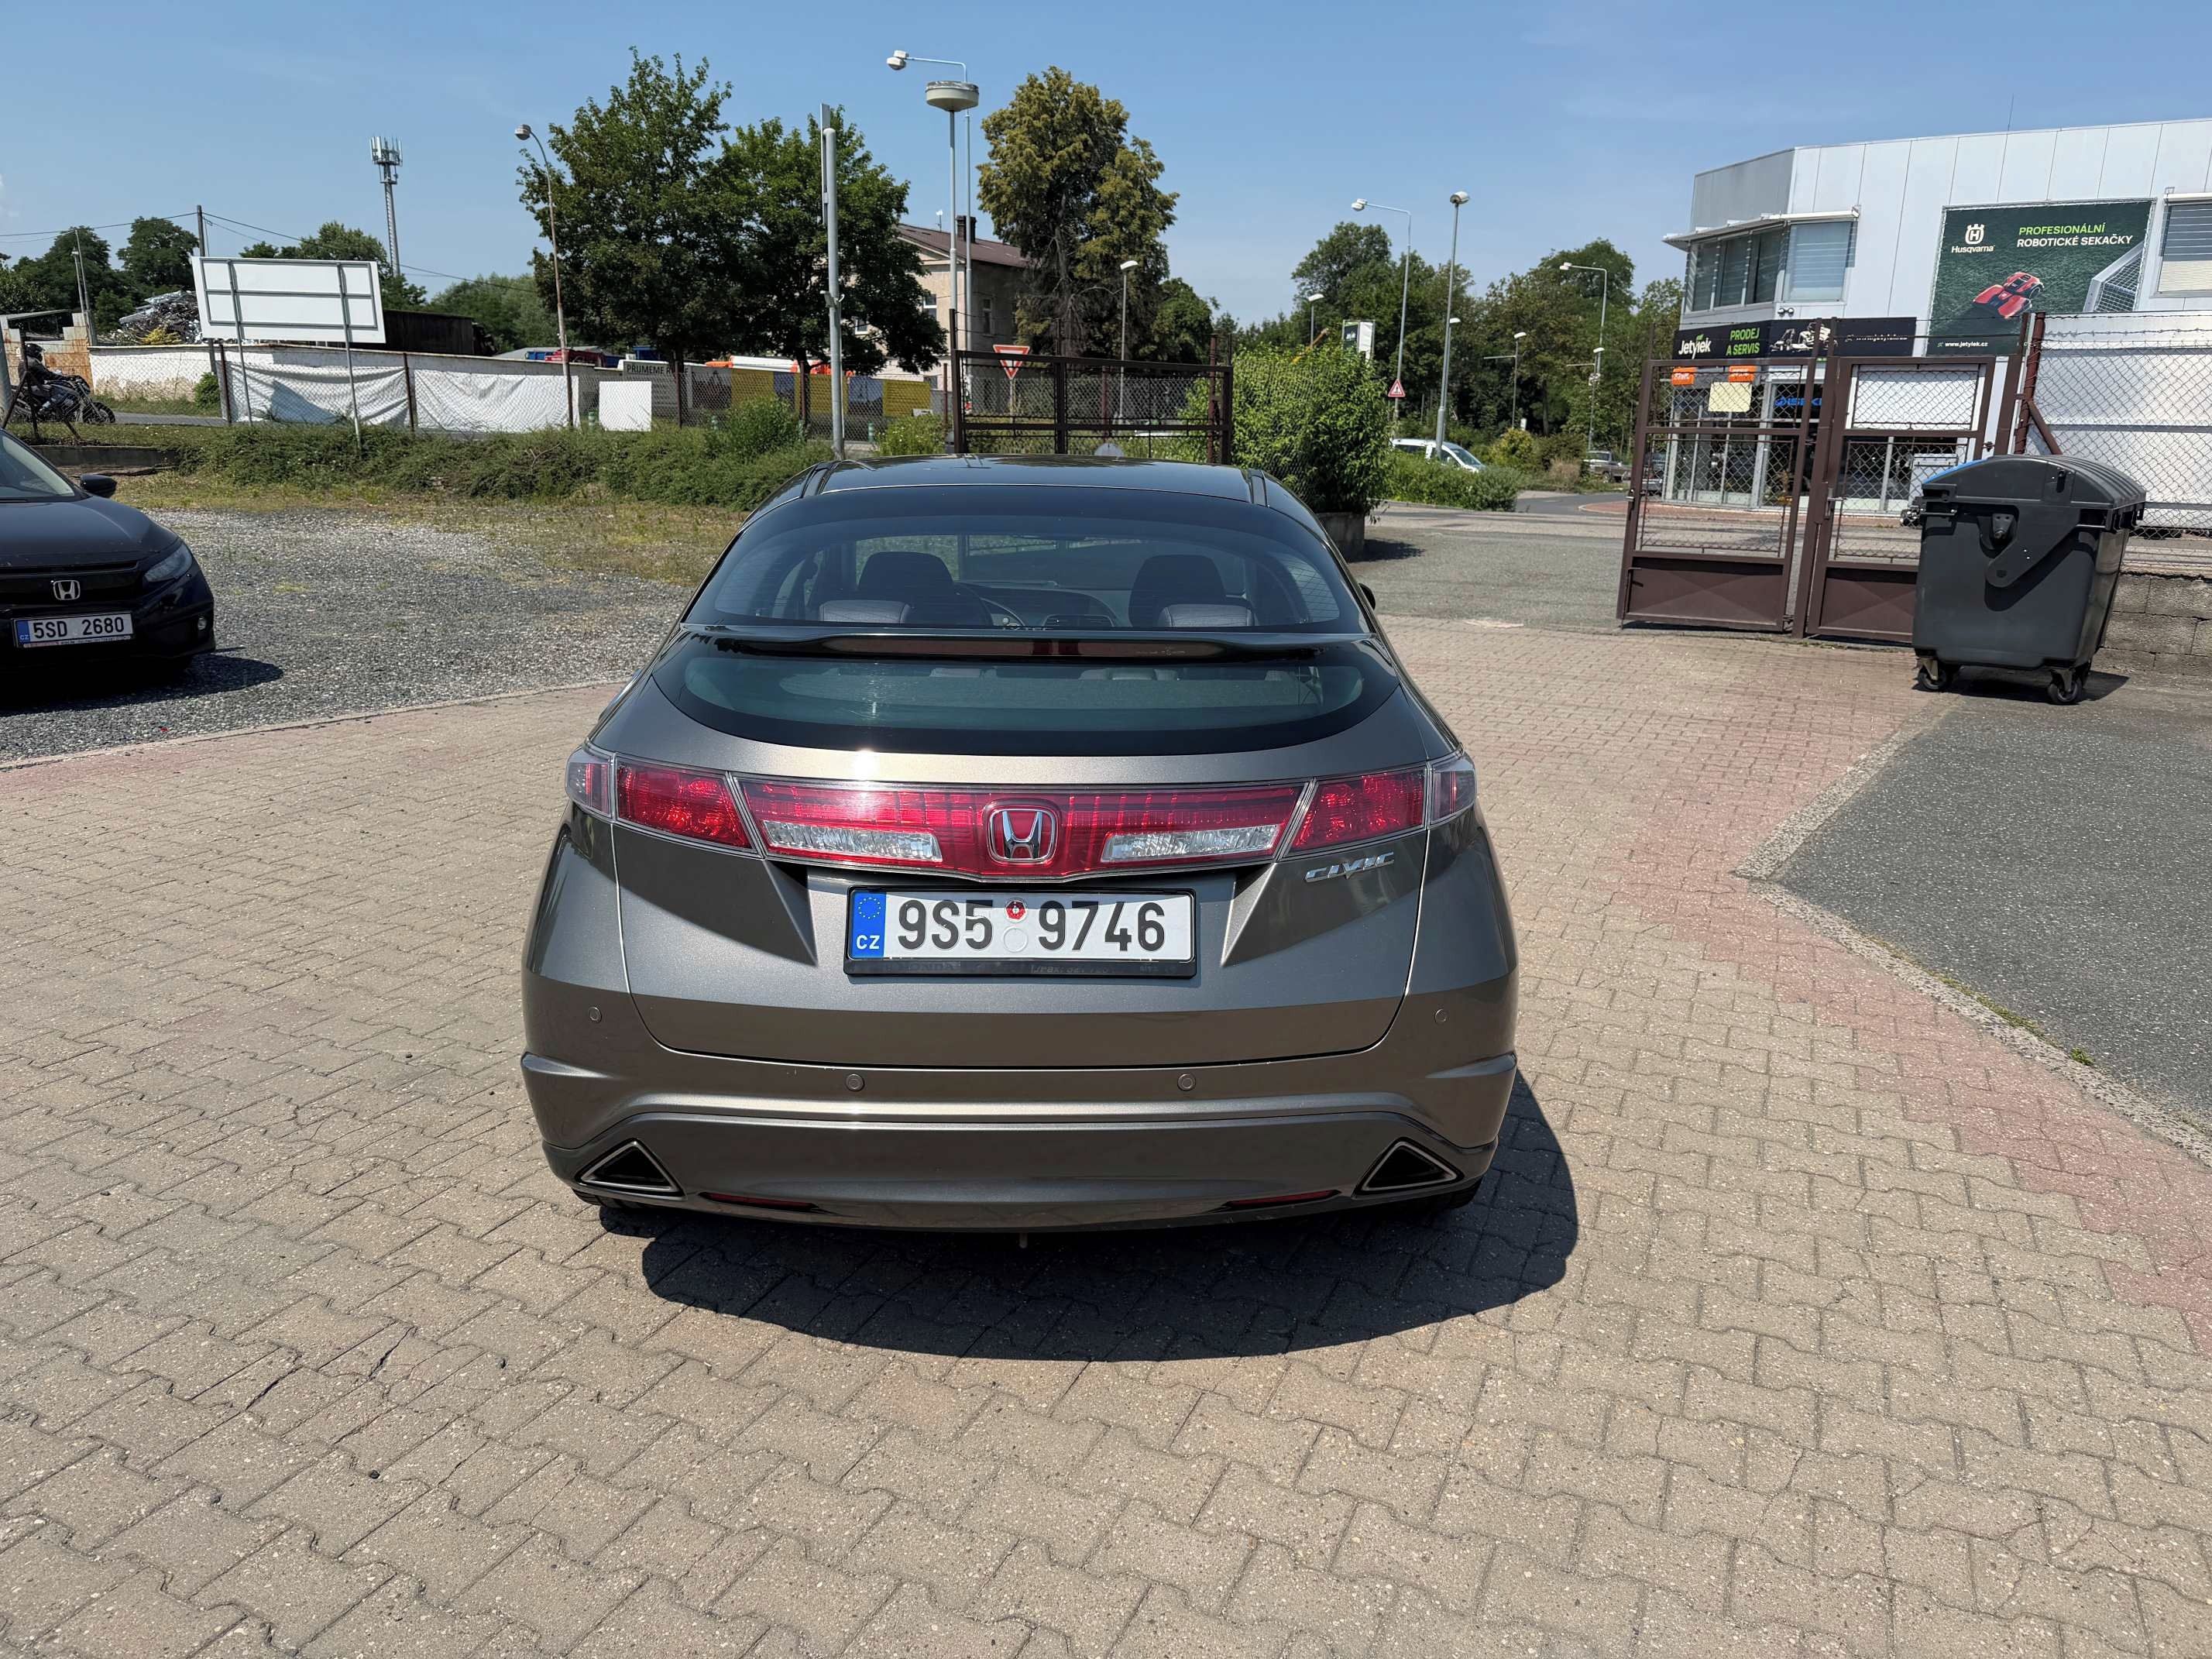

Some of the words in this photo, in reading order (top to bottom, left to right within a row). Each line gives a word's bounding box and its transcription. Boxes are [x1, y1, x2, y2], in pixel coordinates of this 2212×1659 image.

[2018, 222, 2106, 235] PROFESIONÁLNÍ
[2017, 235, 2079, 248] ROBOTICKÉ
[2080, 234, 2133, 246] SEKAČKY
[1729, 328, 1760, 341] PRODEJ
[1726, 345, 1732, 356] A
[1733, 342, 1760, 356] SERVIS
[33, 620, 68, 639] 5SD
[81, 617, 125, 636] 2680
[1304, 852, 1394, 883] CIVIC
[898, 899, 994, 950] 9S5
[1038, 900, 1166, 952] 9746
[856, 934, 881, 950] CZ
